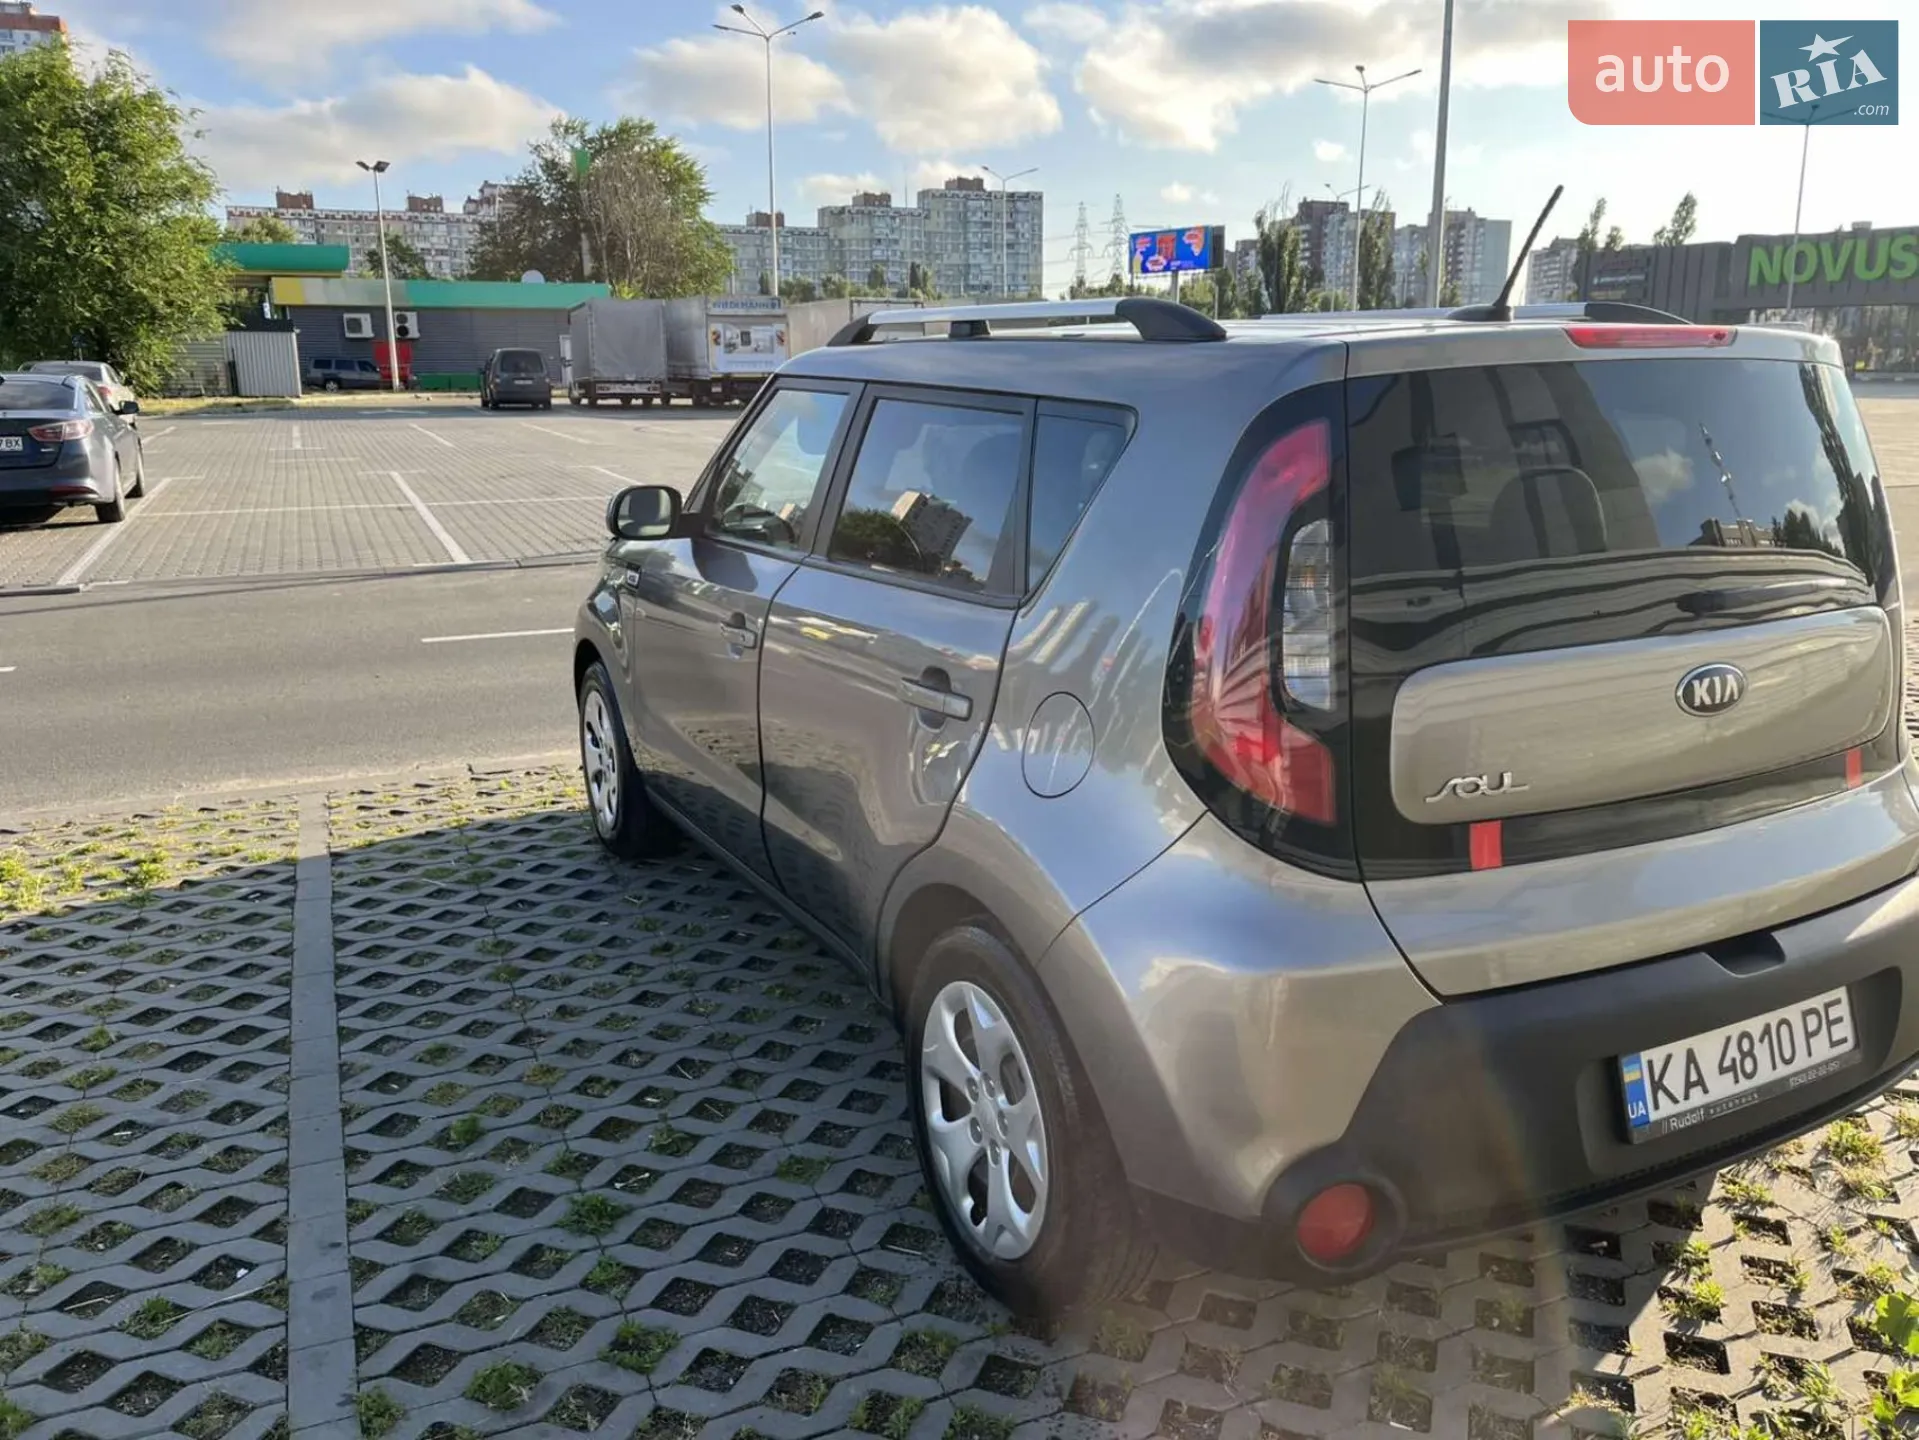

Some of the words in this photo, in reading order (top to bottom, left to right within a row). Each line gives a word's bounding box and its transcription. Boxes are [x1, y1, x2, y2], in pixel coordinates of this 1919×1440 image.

[1749, 234, 1918, 286] NOVUS
[1692, 673, 1739, 707] KIA
[1424, 771, 1531, 804] SOUL
[1647, 1047, 1710, 1111] KA
[1717, 1017, 1797, 1085] 4810
[1801, 997, 1849, 1059] PE
[1628, 1101, 1647, 1119] UA
[1670, 1107, 1705, 1131] Rudolf
